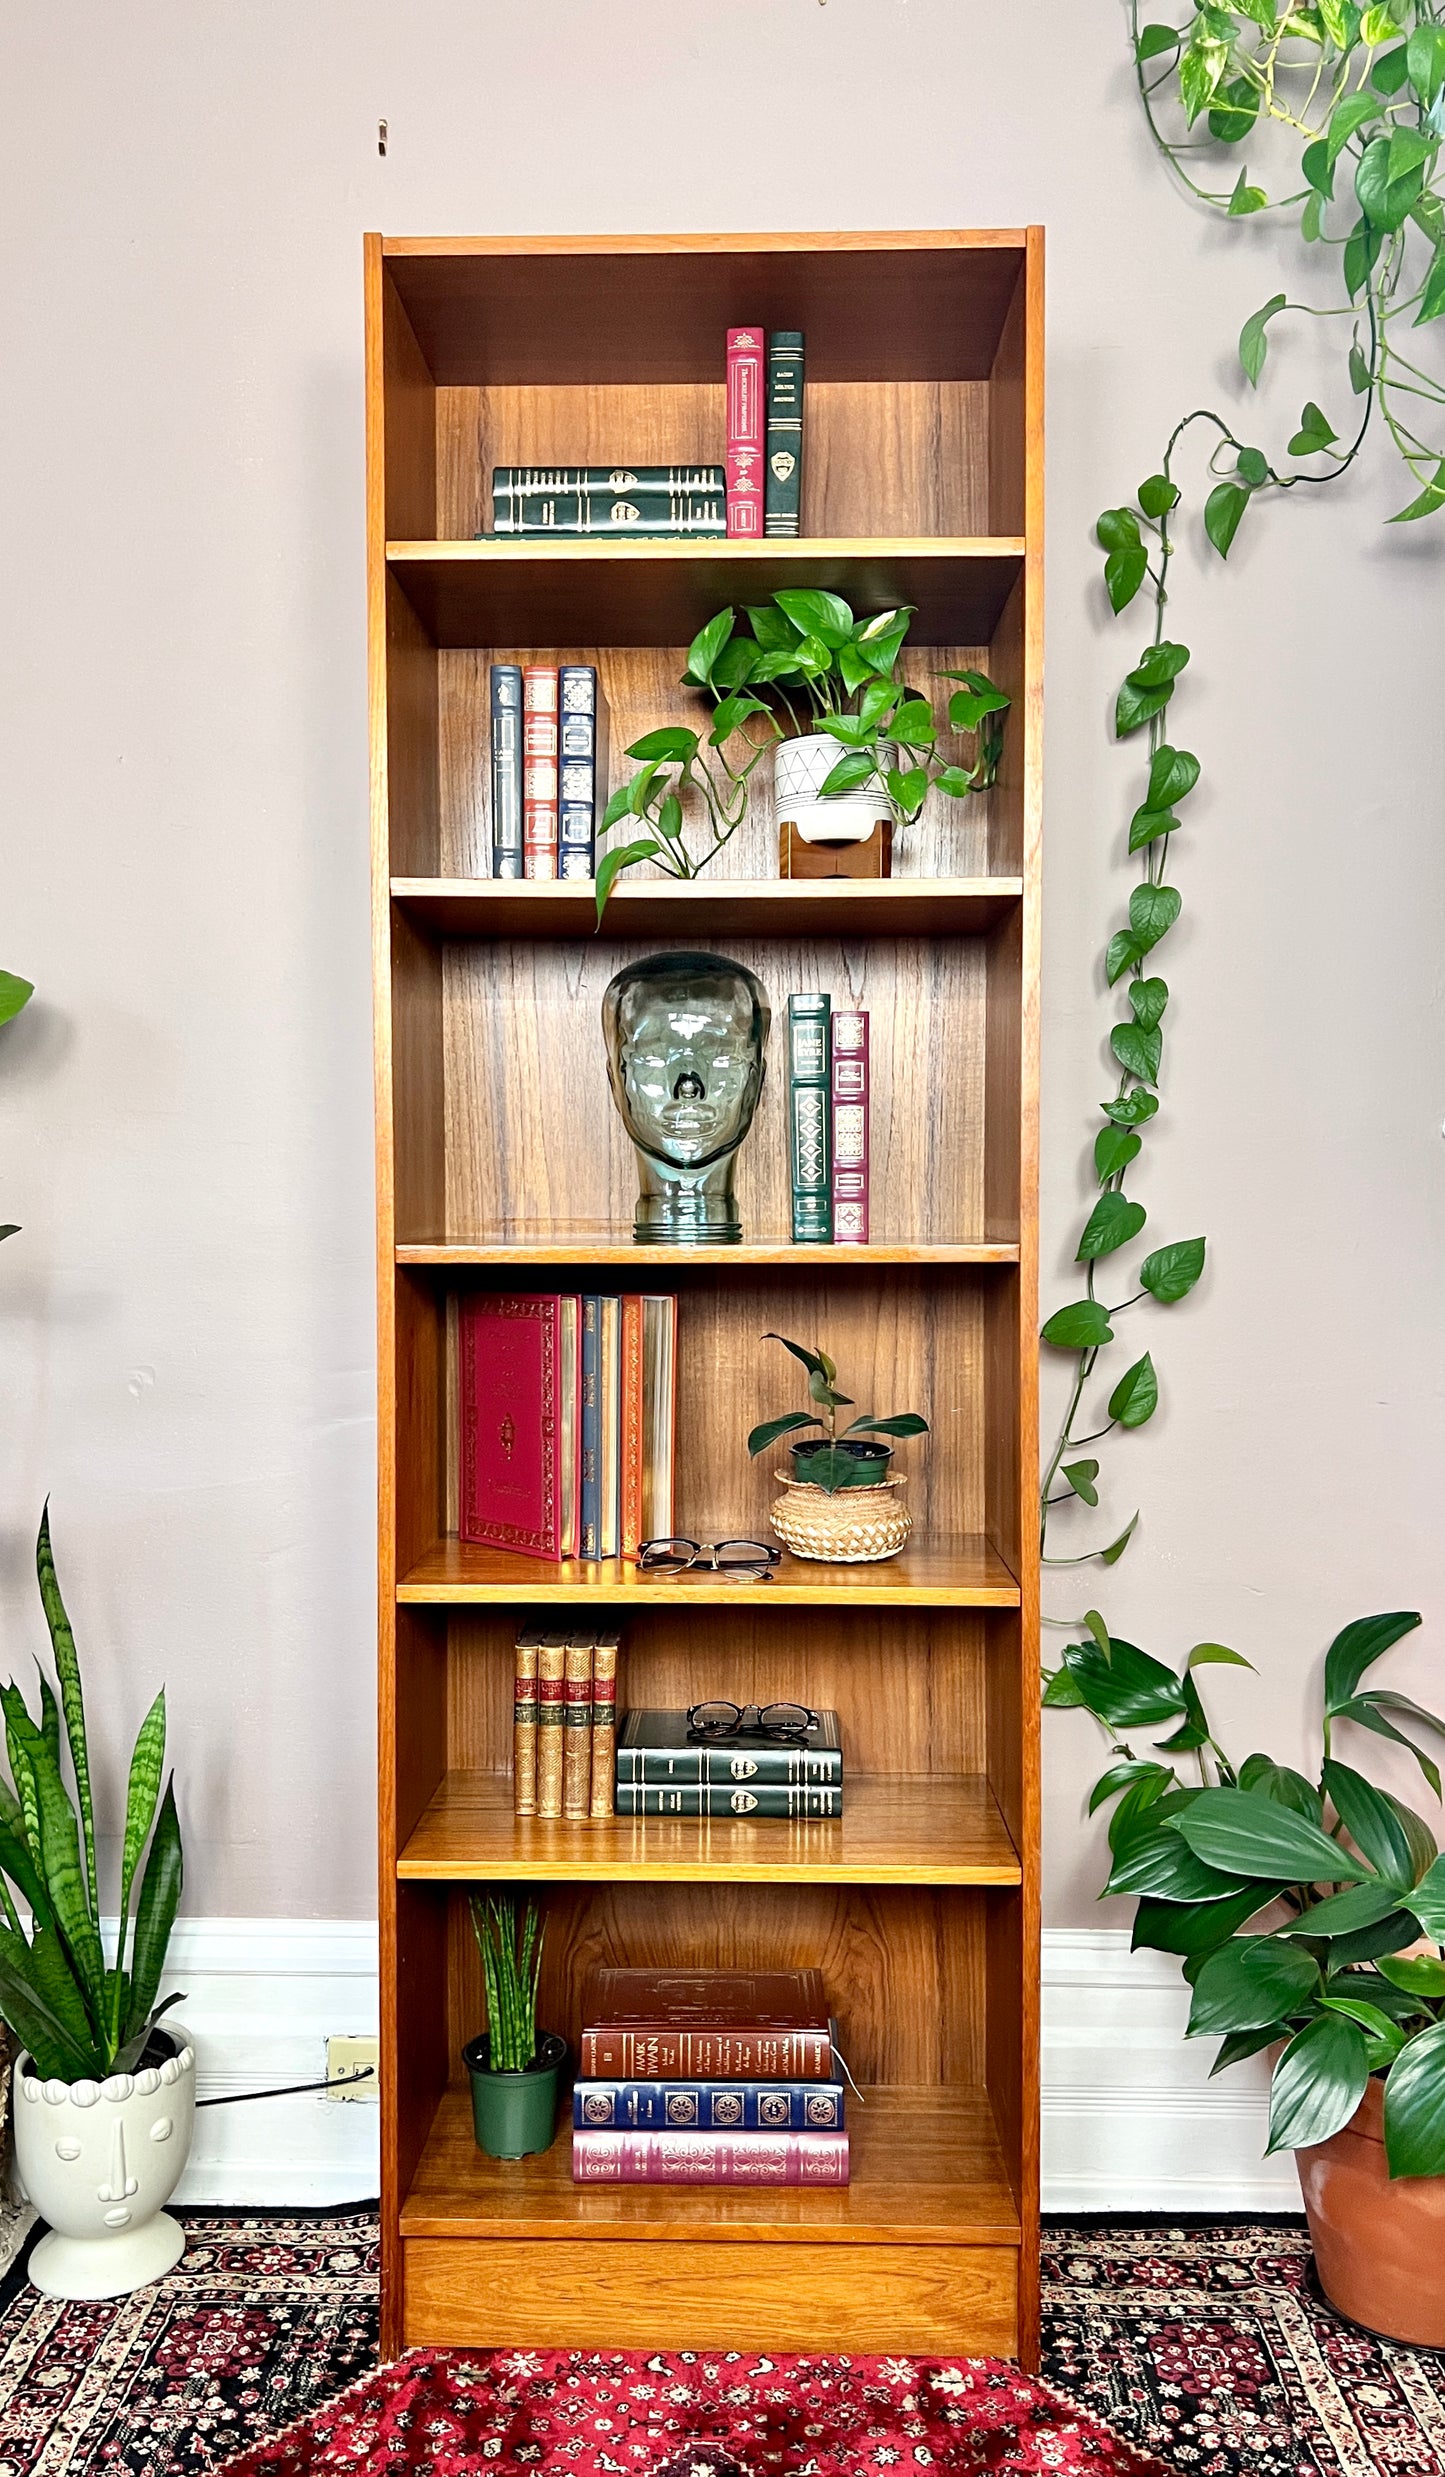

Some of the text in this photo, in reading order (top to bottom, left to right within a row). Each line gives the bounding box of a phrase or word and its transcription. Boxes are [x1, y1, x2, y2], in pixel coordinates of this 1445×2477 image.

[797, 1047, 822, 1057] EYRE
[798, 1038, 822, 1048] JANE
[635, 2042, 645, 2071] MARK
[647, 2037, 659, 2075] TWAIN
